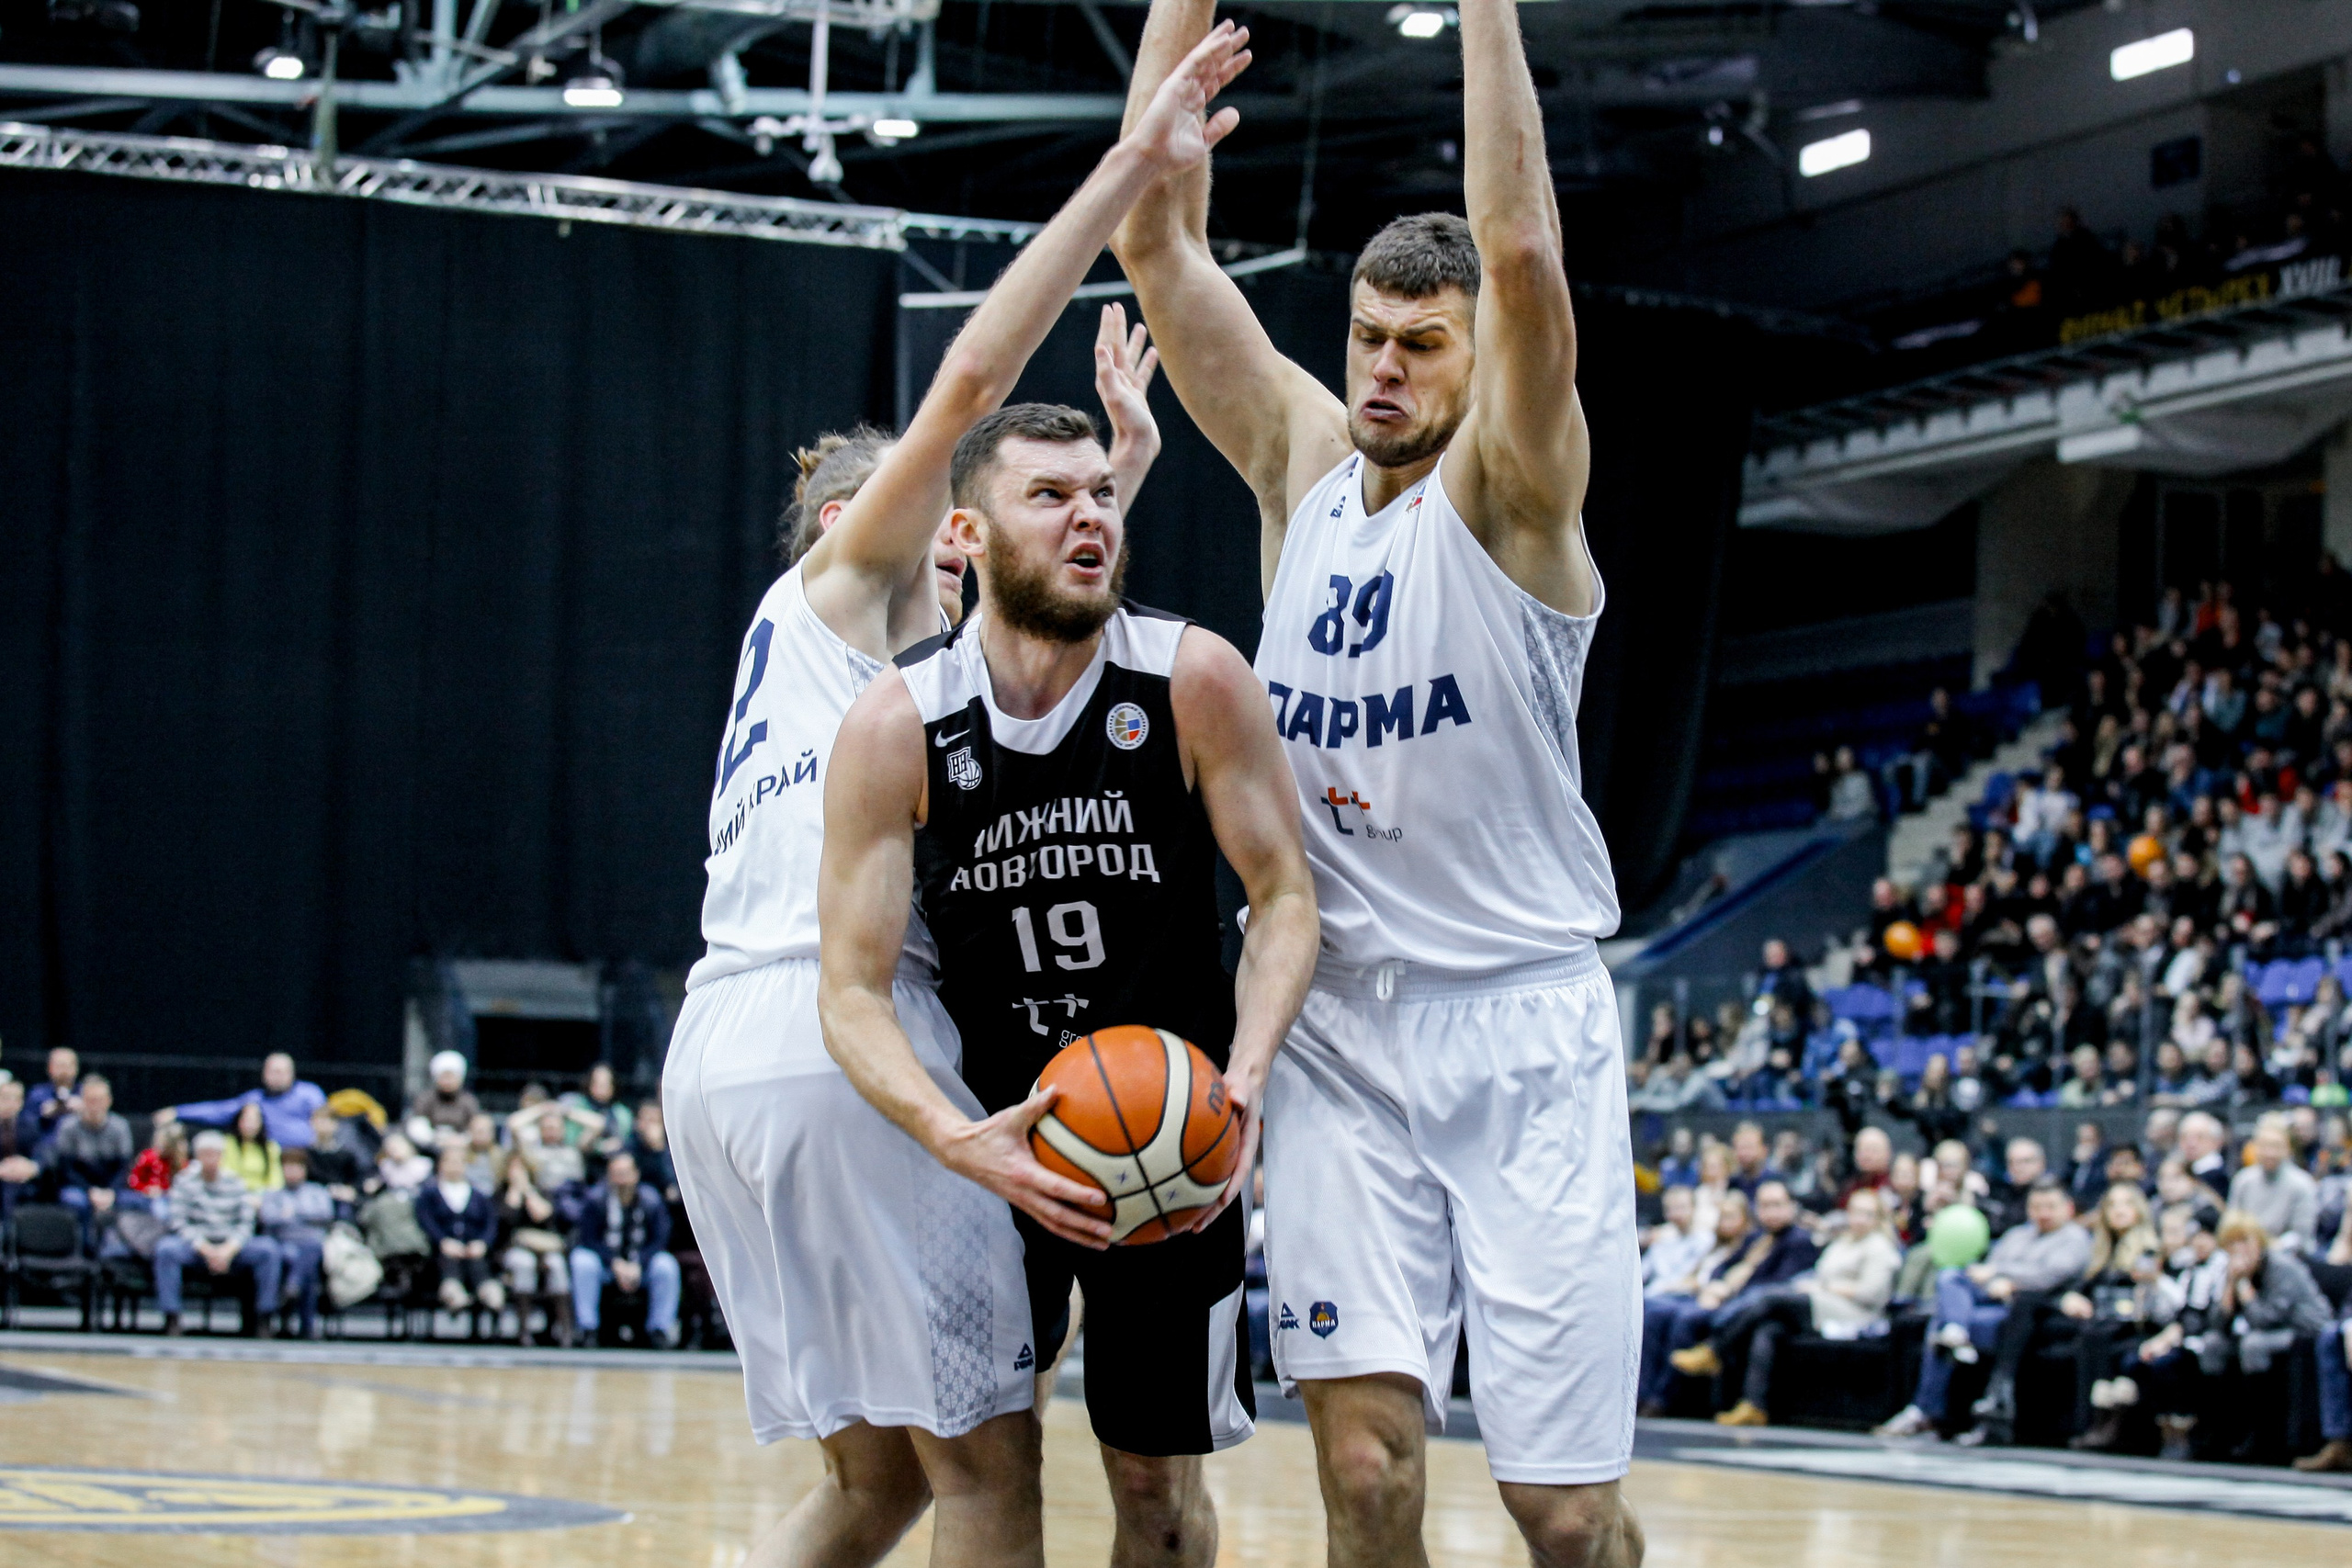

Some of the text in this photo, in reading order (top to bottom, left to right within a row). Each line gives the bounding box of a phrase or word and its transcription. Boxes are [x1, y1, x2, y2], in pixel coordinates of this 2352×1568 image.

[1307, 570, 1394, 658] 89
[716, 617, 775, 800] 2
[1269, 673, 1472, 749] ПАРМА
[1012, 900, 1106, 973] 19
